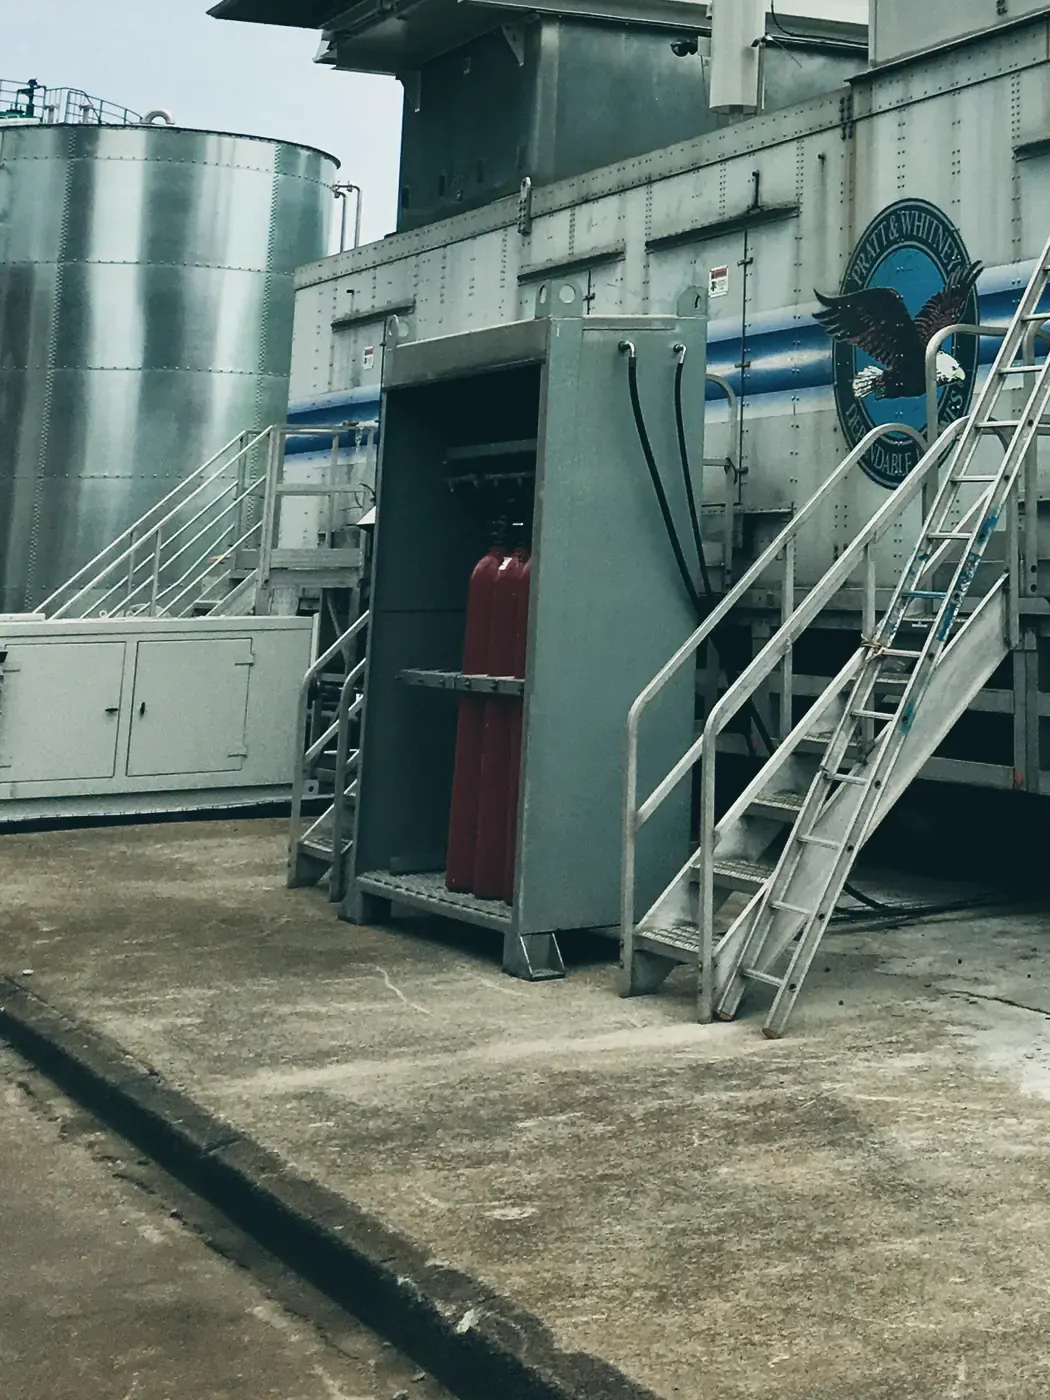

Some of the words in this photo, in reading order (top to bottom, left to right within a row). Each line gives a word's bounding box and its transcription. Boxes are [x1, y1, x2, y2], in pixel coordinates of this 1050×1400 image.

[851, 221, 888, 284] PRATT
[888, 215, 900, 240] &
[900, 210, 962, 271] WHITNEY
[845, 403, 912, 477] DEPNDABLE
